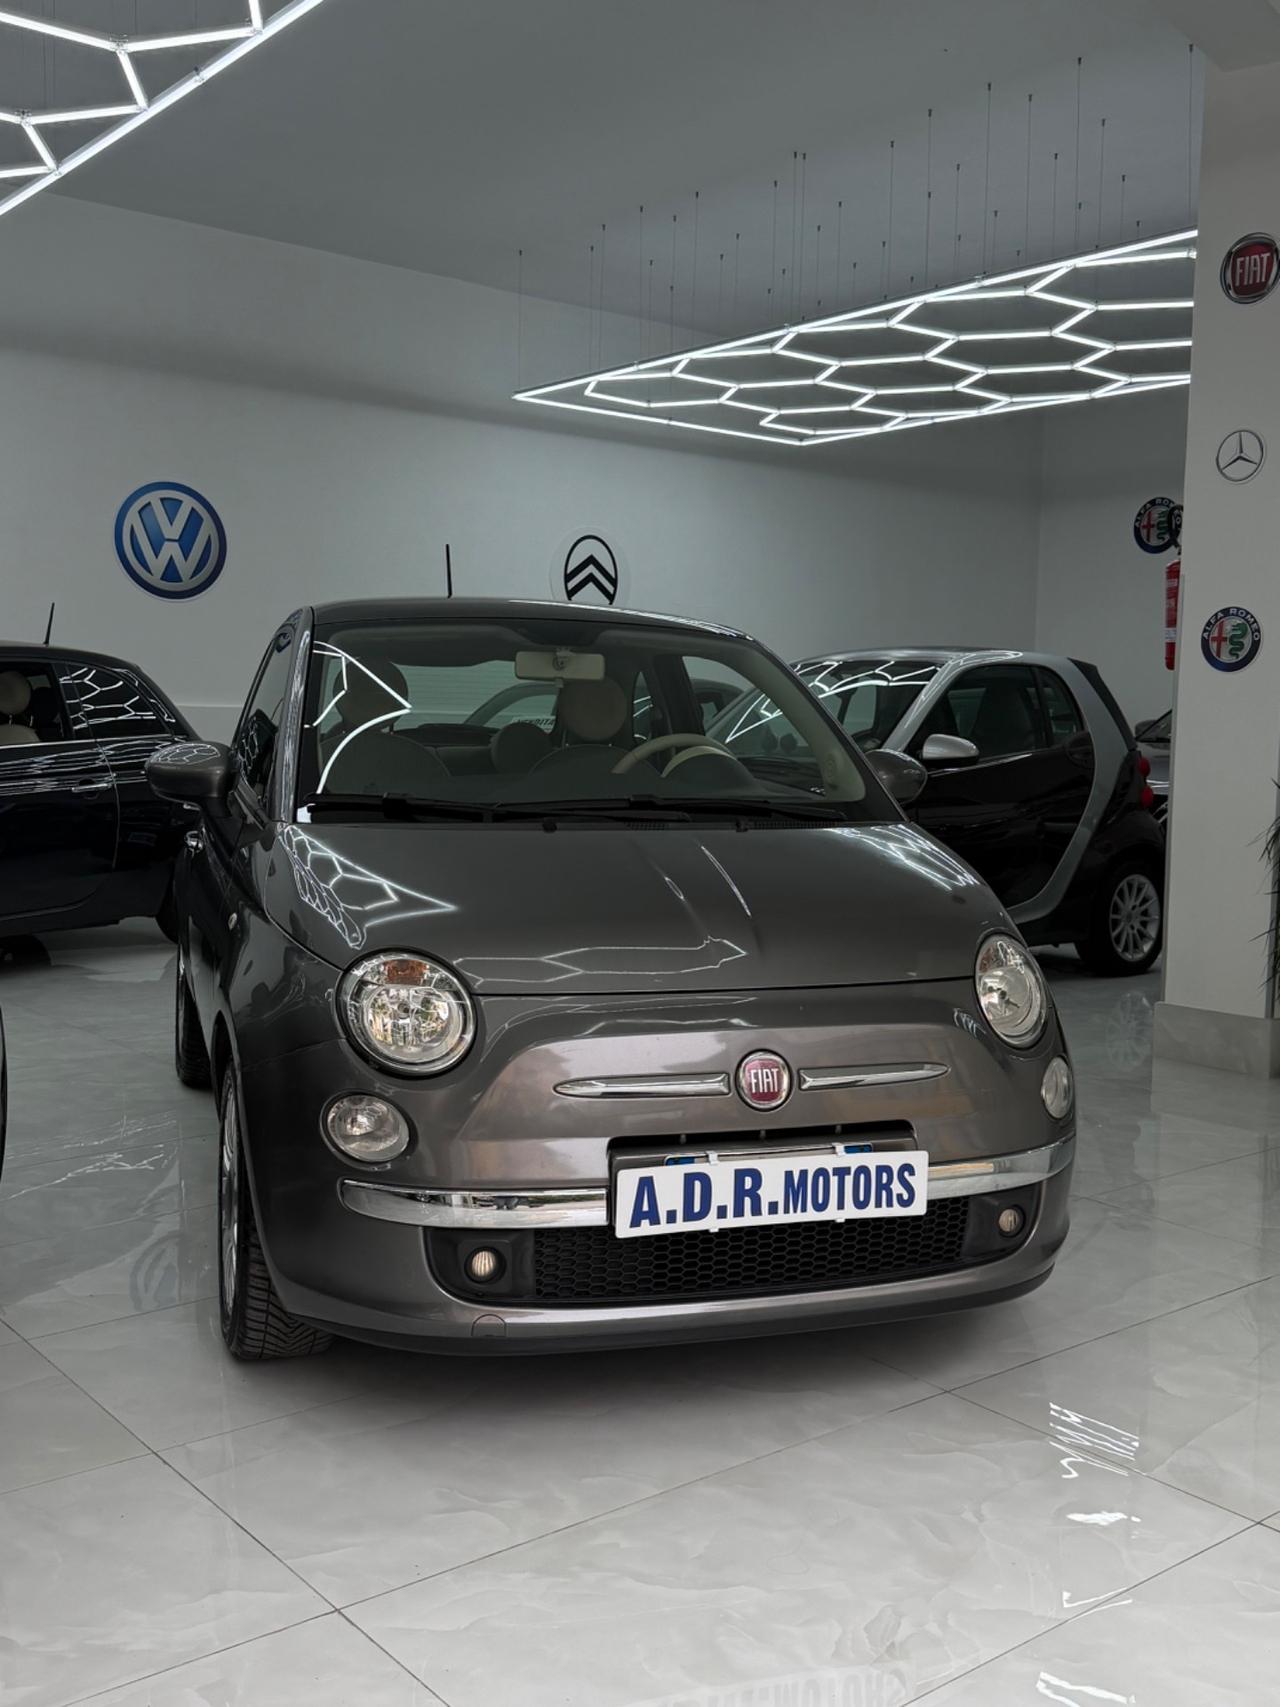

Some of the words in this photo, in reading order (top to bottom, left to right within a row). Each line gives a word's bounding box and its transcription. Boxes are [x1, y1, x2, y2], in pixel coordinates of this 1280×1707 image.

[1235, 252, 1271, 286] FIAT
[1202, 612, 1224, 639] ALFA
[1229, 608, 1260, 640] ROMEO
[750, 1068, 779, 1093] FIAT
